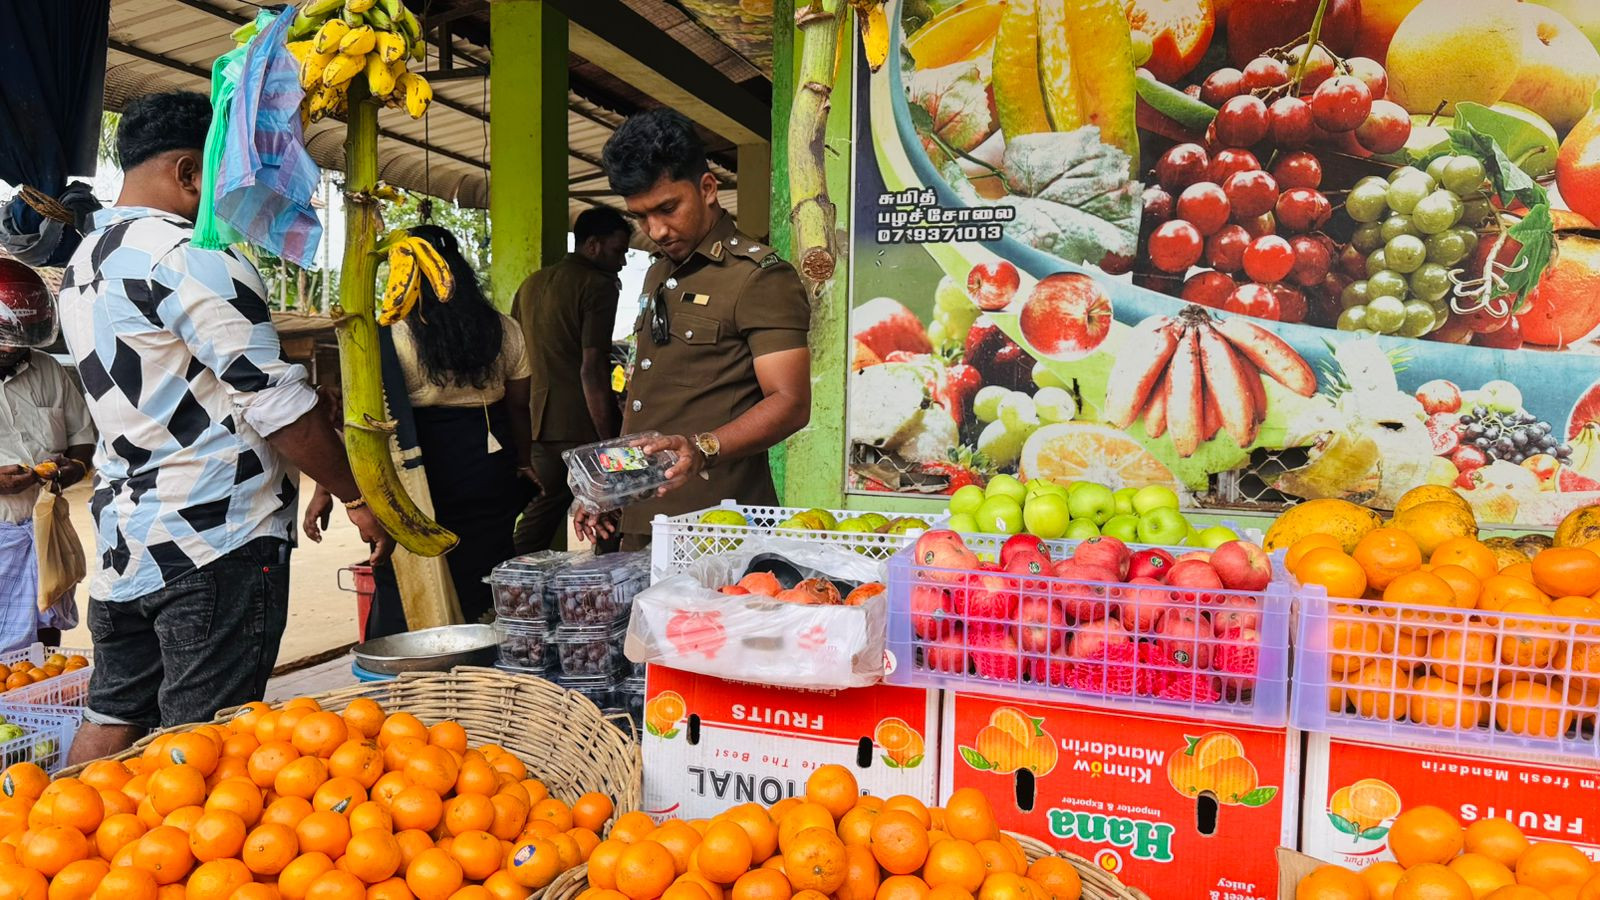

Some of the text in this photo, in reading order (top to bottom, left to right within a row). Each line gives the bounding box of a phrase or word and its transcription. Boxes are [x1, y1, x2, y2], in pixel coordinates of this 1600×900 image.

[879, 189, 936, 206] சுமித்
[732, 704, 824, 730] FRUITS
[716, 749, 750, 762] Best
[762, 755, 789, 768] The
[1061, 738, 1164, 766] Mandarin
[1073, 759, 1152, 784] Kinnow
[1421, 760, 1509, 782] Mandarin
[1519, 772, 1570, 789] fresh
[1061, 796, 1161, 817] Importer & Exporter
[1046, 807, 1176, 863] Hana
[1217, 878, 1256, 893] Juicy
